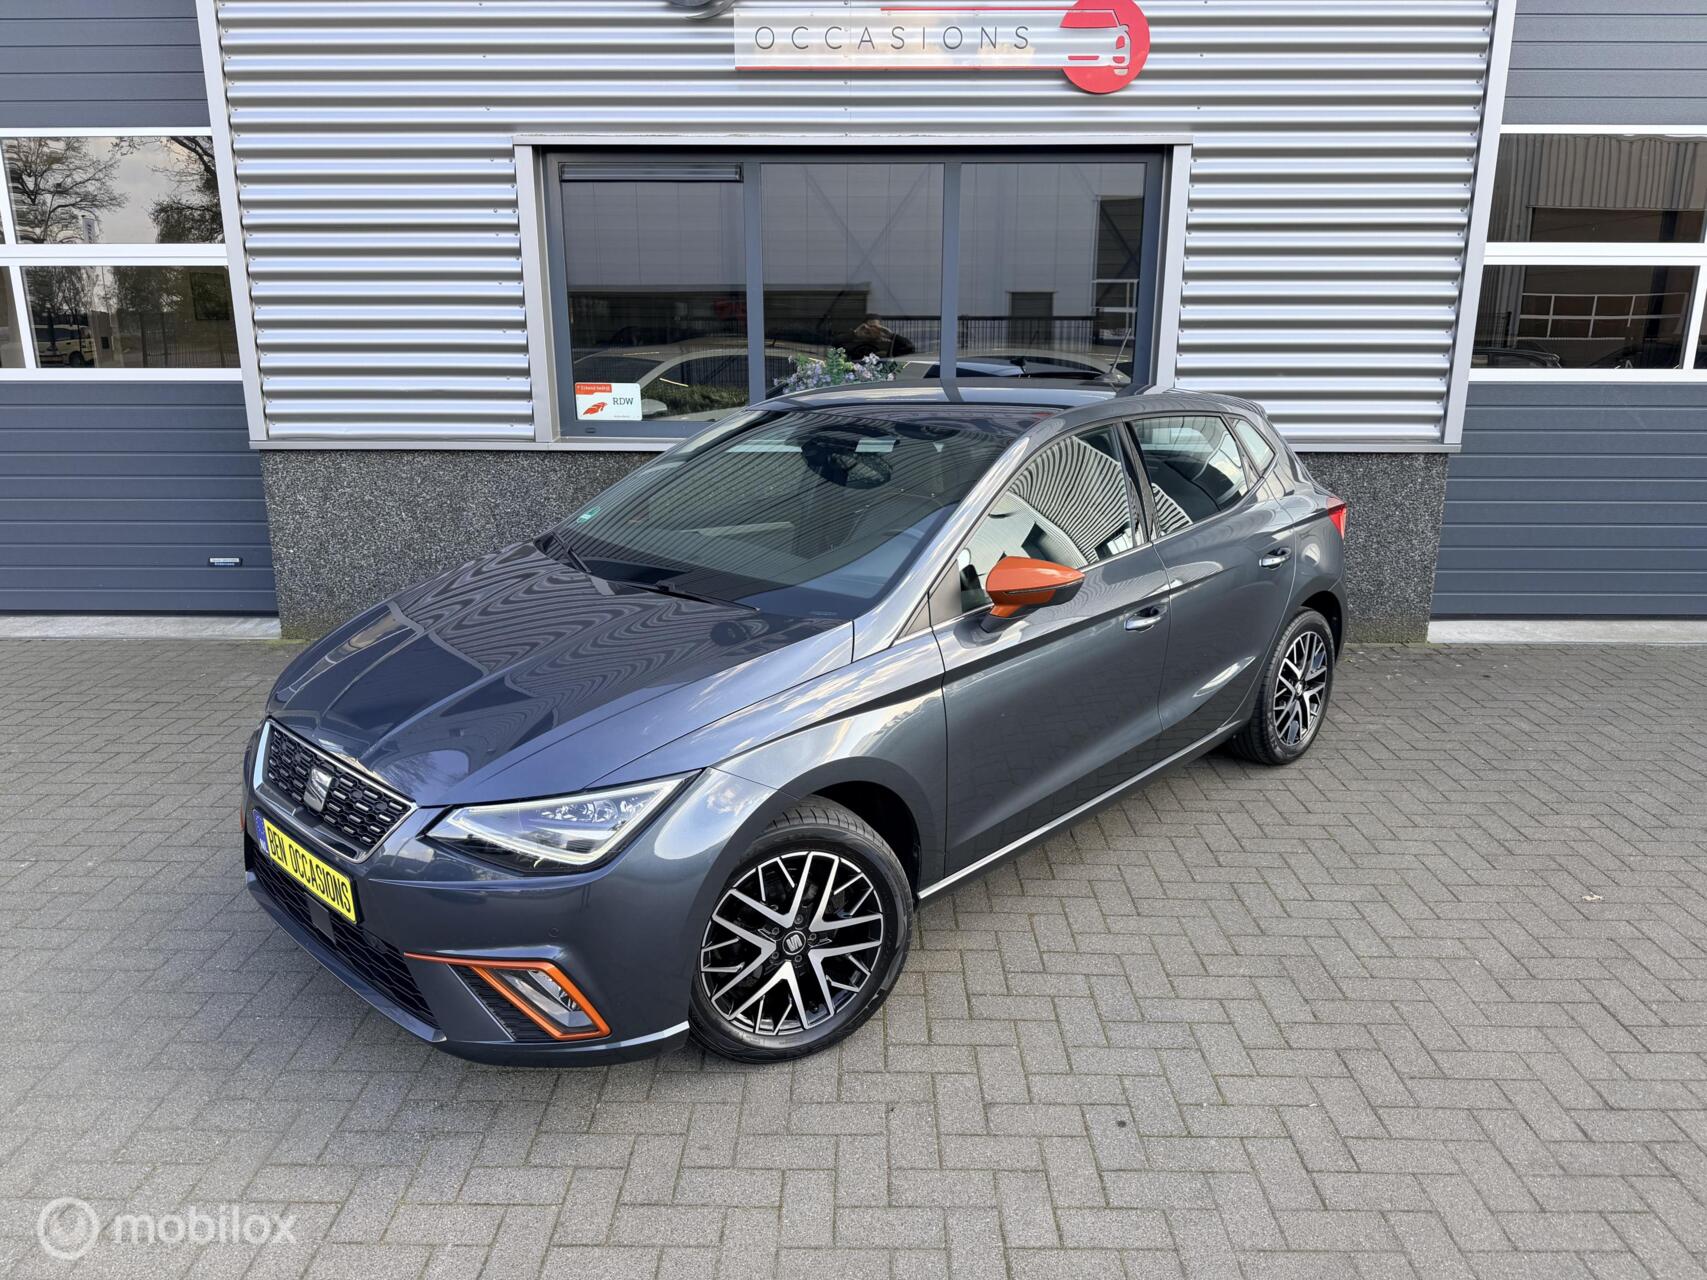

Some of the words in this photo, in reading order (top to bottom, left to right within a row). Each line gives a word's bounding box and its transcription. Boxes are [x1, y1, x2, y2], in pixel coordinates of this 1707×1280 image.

[754, 25, 1030, 50] OCCASIONS
[612, 397, 634, 405] RDW
[267, 826, 288, 867] BEN
[288, 843, 351, 914] OCCASIONS
